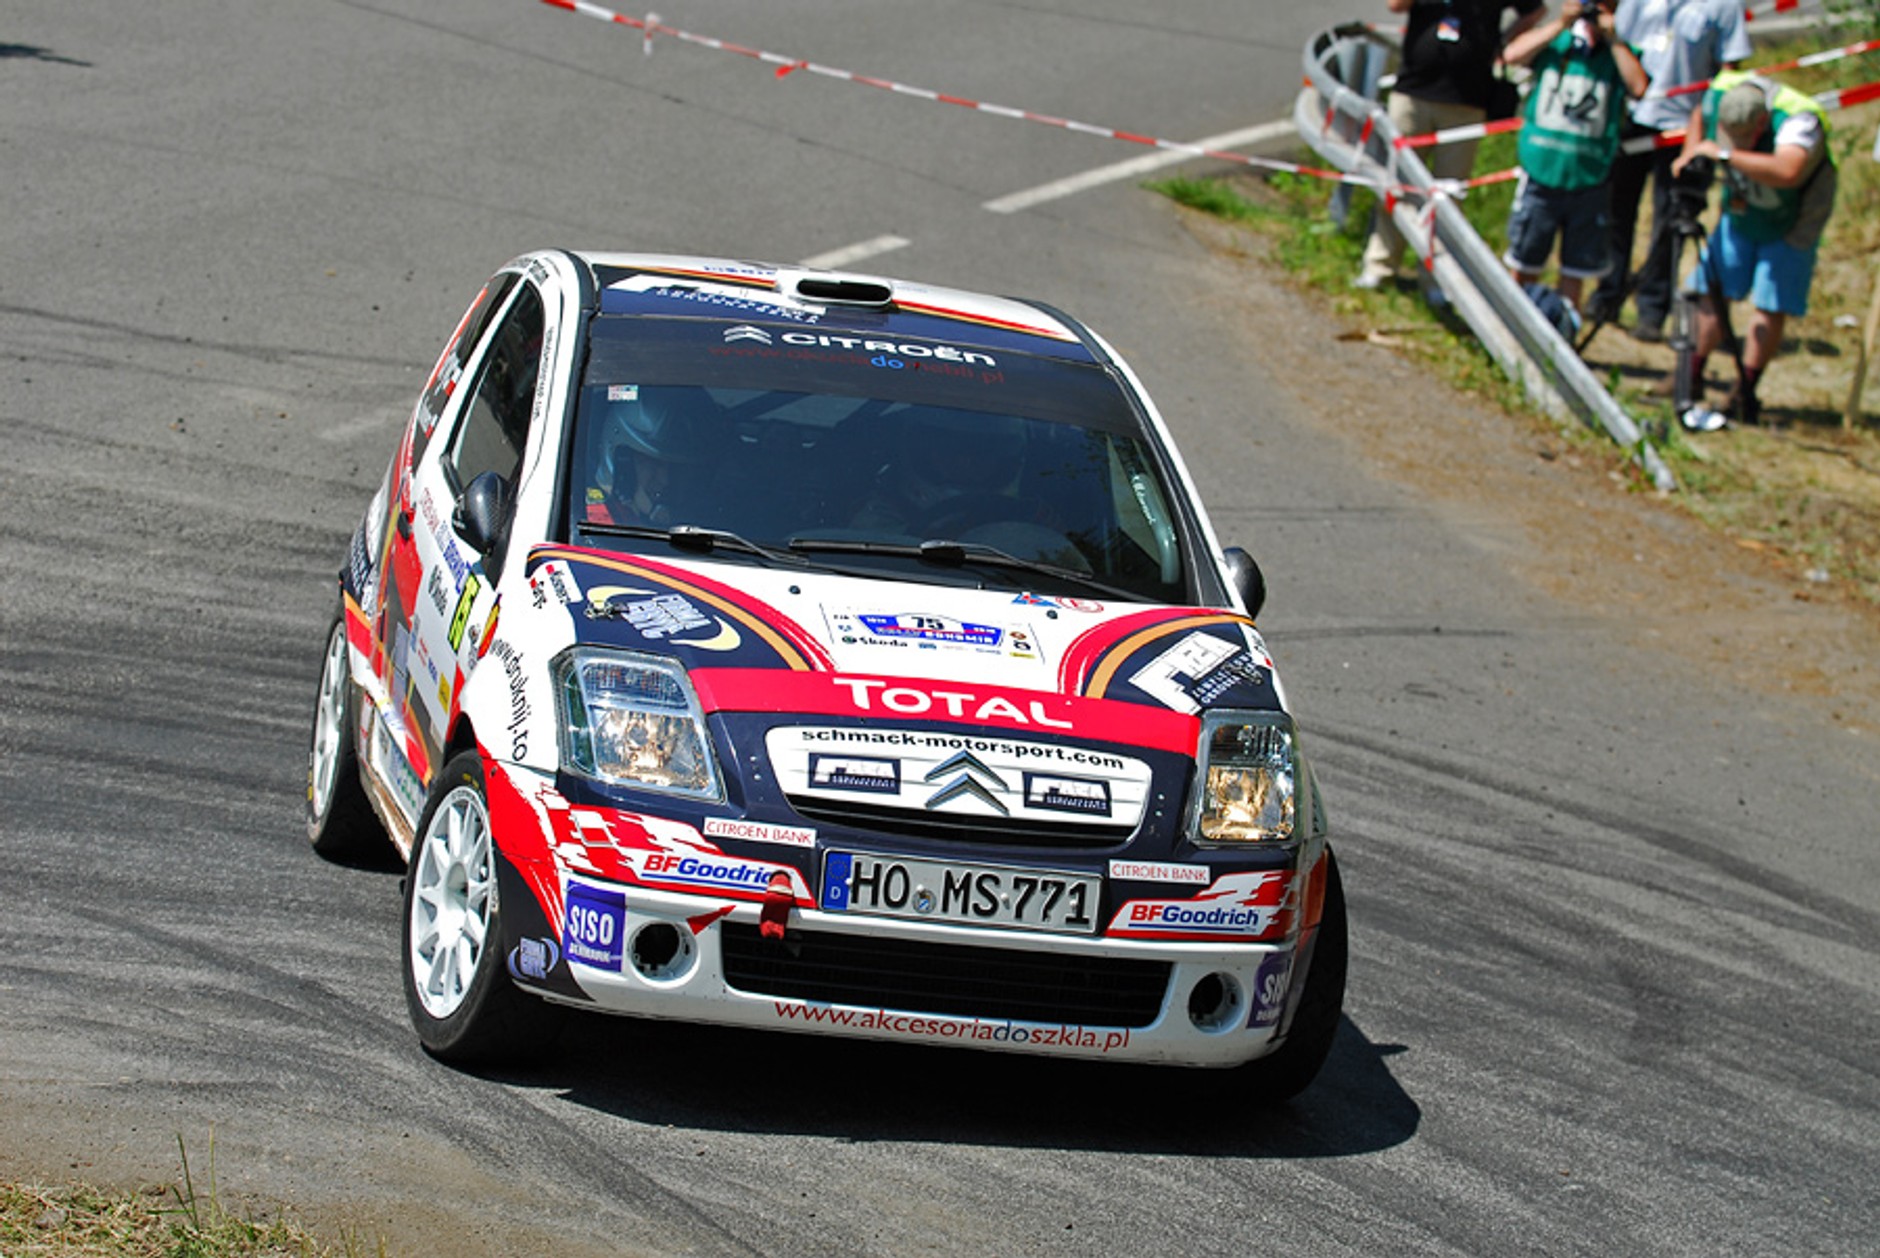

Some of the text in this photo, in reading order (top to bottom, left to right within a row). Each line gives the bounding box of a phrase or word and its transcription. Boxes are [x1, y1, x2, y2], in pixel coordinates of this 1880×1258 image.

[910, 615, 946, 632] 75
[832, 676, 1074, 729] TOTAL
[801, 728, 1125, 771] schmack-motorsport.com
[773, 827, 813, 846] BANK
[642, 854, 776, 884] BFGoodric
[1172, 865, 1208, 881] BANK
[829, 886, 841, 900] D
[850, 860, 1091, 925] HO MS 771
[569, 904, 615, 946] SISO
[1129, 904, 1260, 927] BFGoodrich
[773, 999, 1131, 1052] www.akcesoriadoszkla.pl
